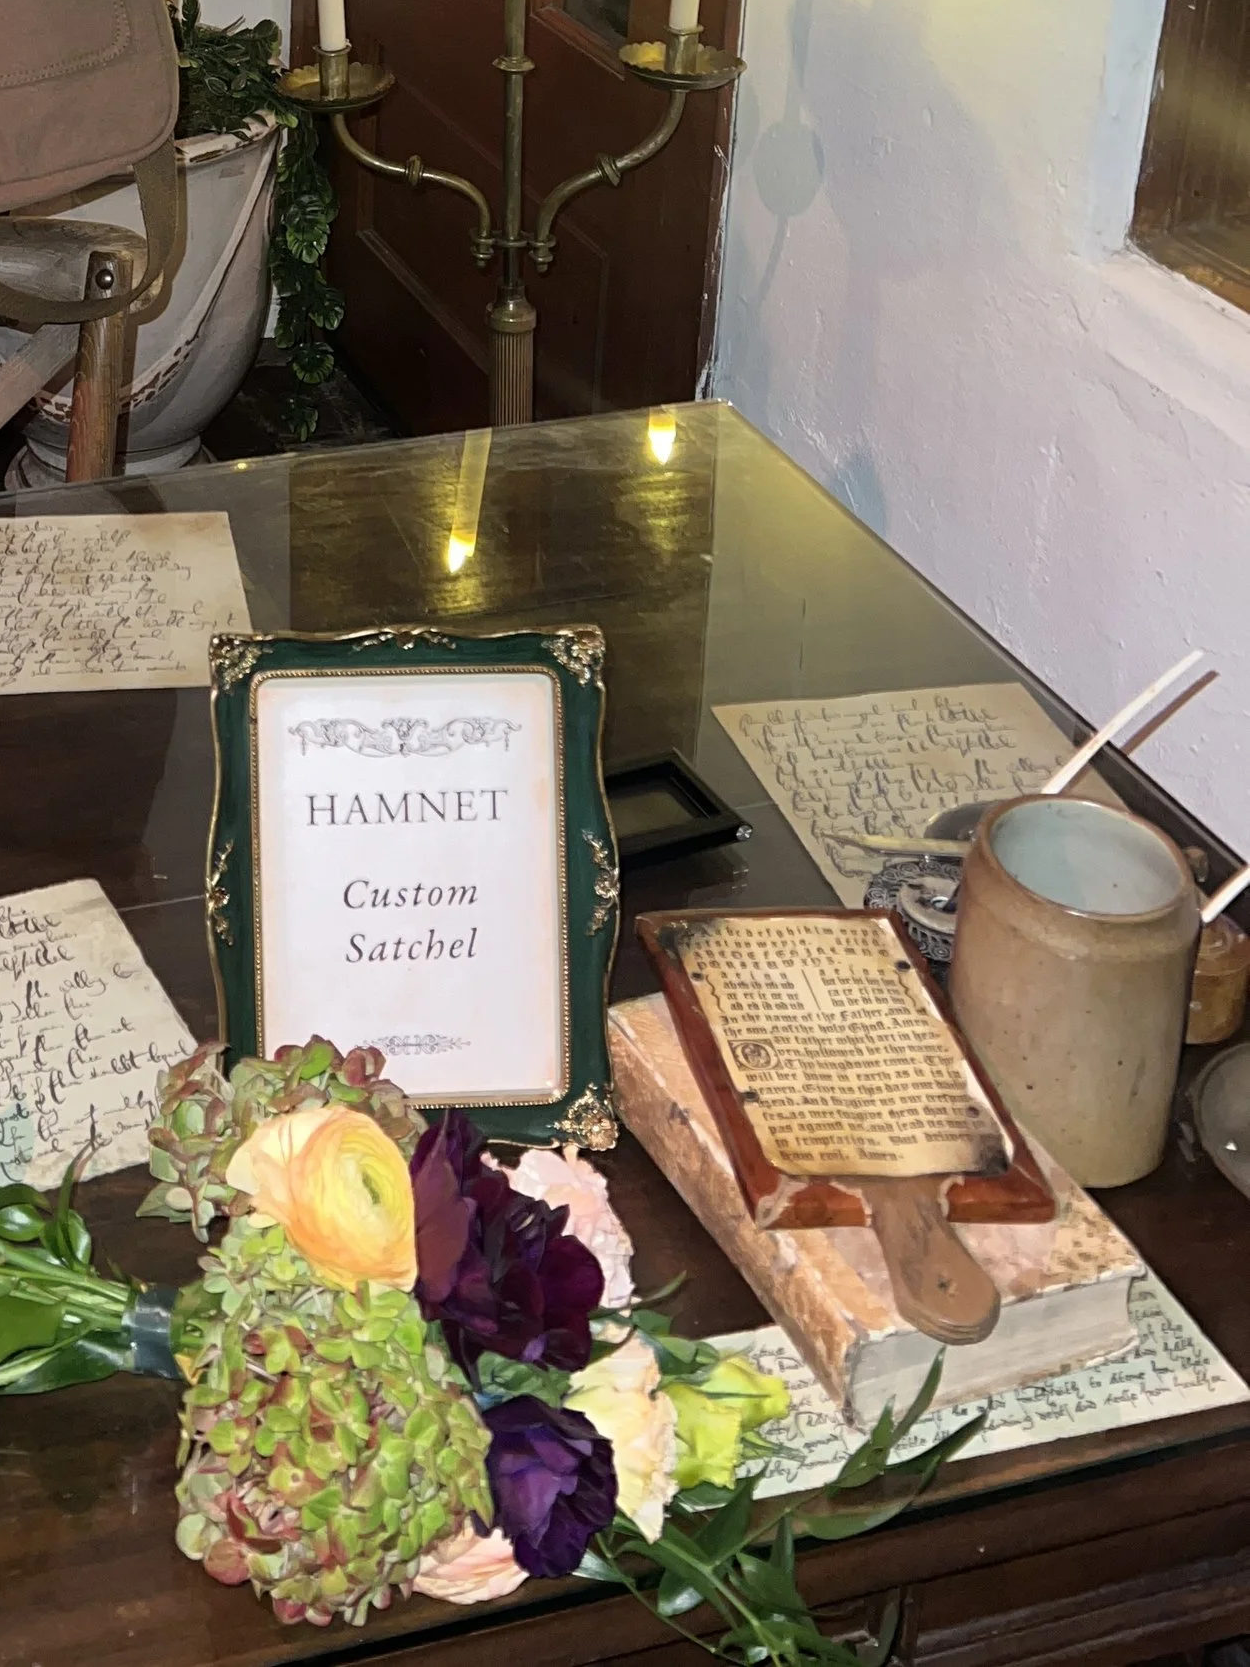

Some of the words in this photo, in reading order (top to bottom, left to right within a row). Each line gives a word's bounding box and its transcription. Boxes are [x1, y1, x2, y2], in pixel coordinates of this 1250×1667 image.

[305, 788, 509, 827] HAMNET
[343, 878, 479, 910] Custom
[345, 927, 479, 964] Satchel
